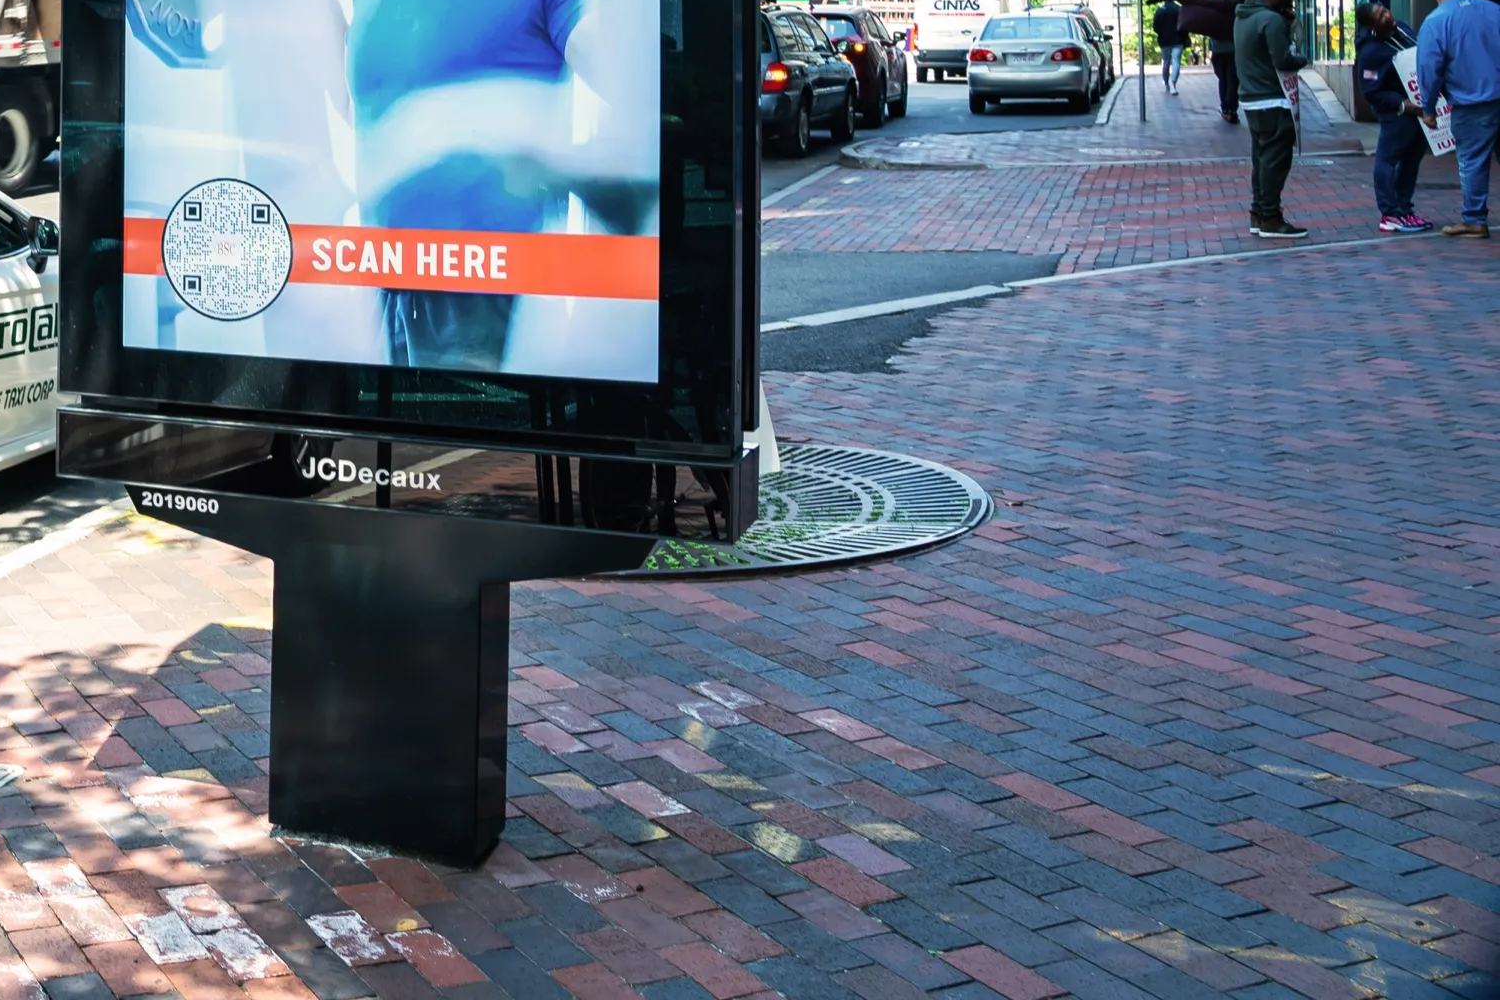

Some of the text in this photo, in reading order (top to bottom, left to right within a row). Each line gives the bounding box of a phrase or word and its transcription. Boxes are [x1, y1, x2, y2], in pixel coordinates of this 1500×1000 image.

[311, 238, 507, 280] SCAN HERE
[3, 385, 27, 411] TAXI
[27, 379, 55, 405] CORP
[301, 456, 441, 491] JCDecaux
[141, 490, 219, 514] 2019060
